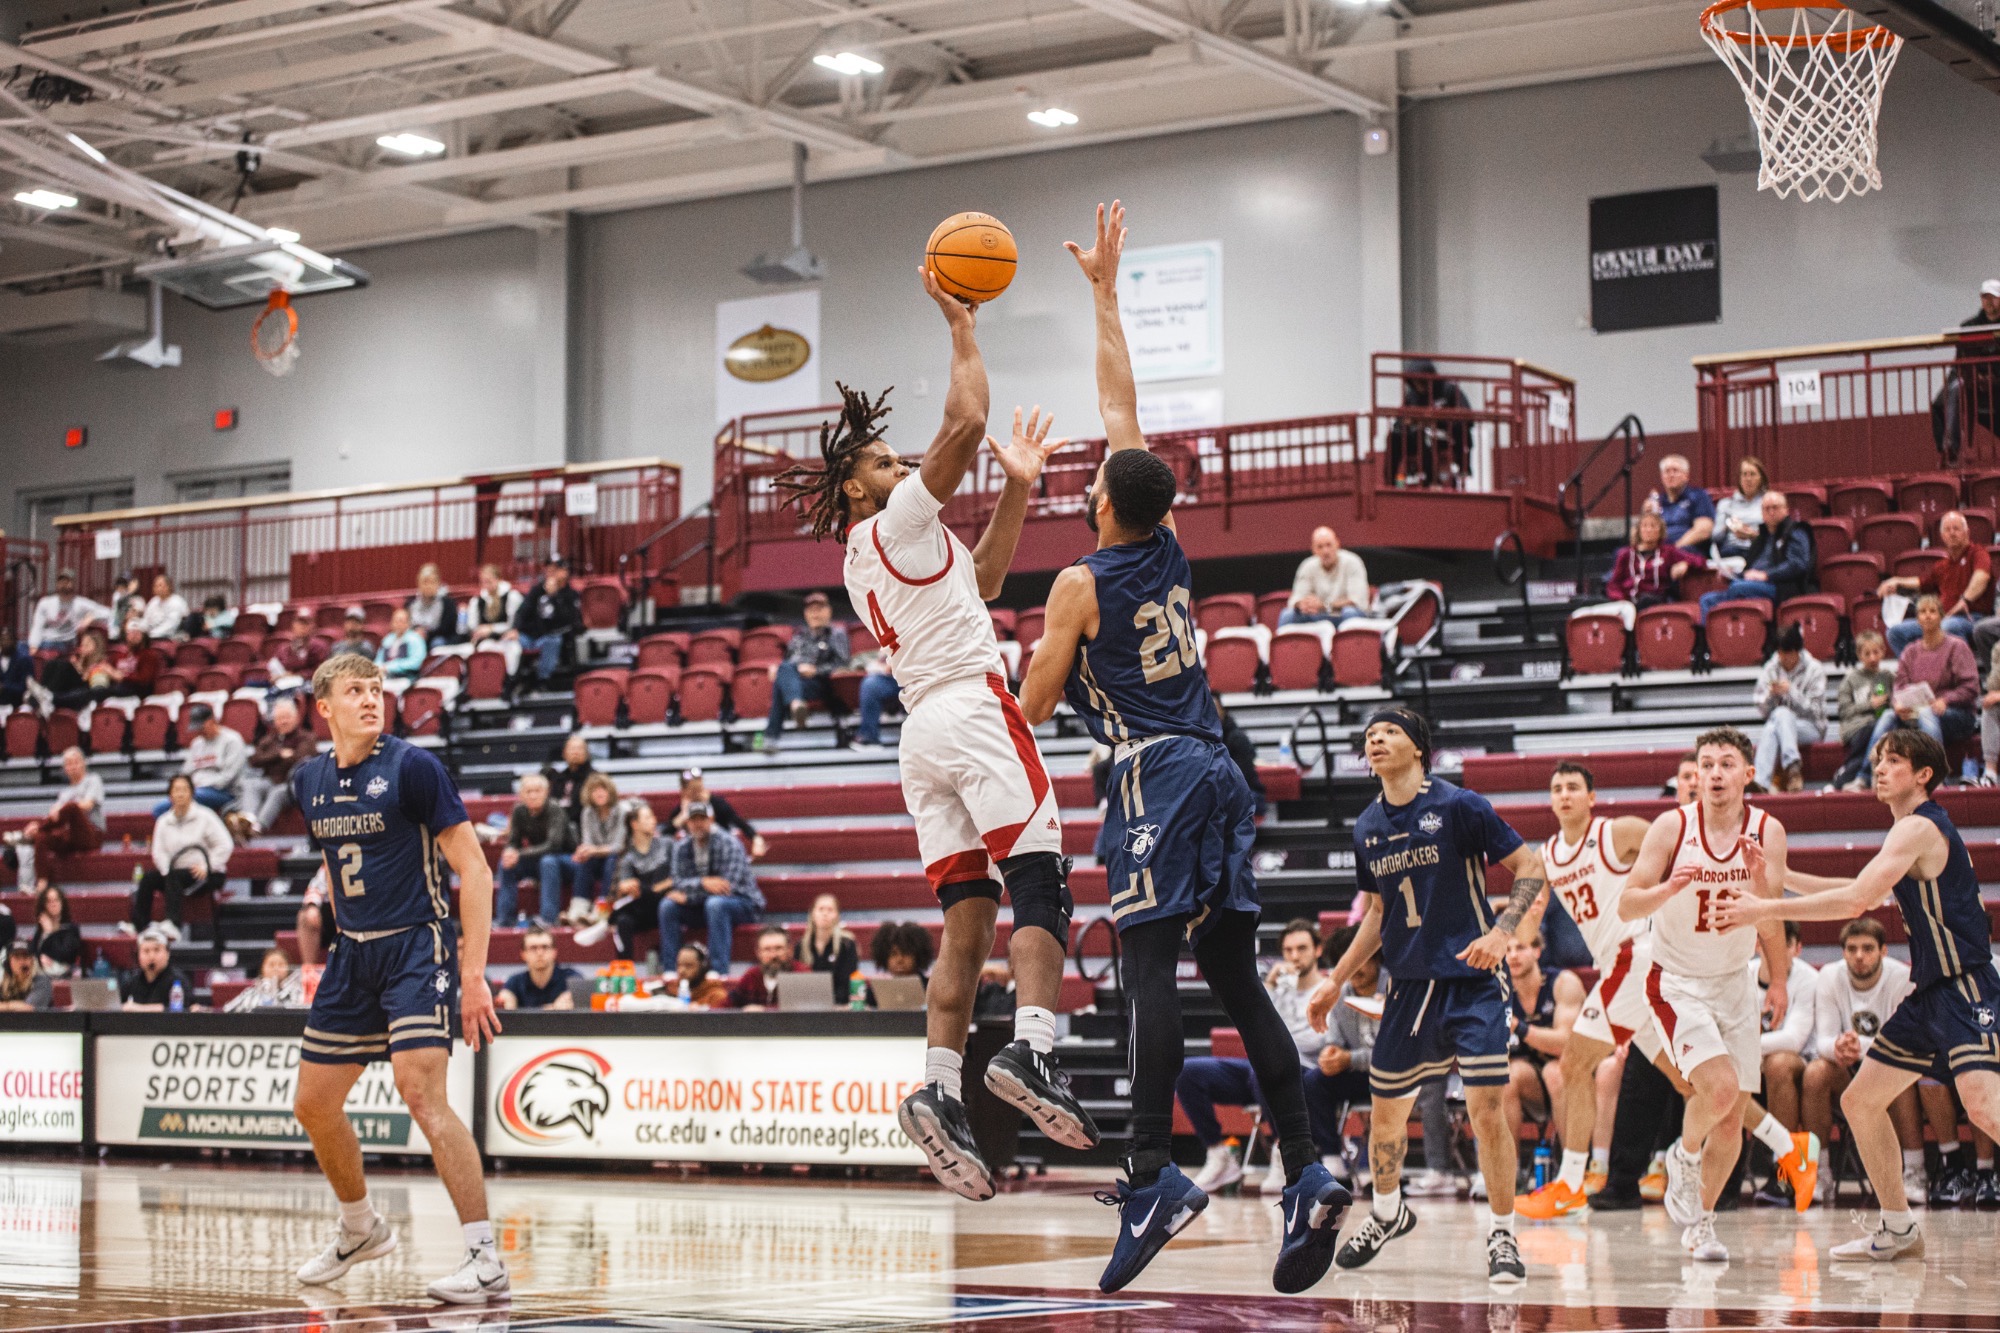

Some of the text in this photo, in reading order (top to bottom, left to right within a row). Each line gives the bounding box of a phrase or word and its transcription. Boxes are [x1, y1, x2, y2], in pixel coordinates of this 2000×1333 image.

[1664, 243, 1704, 263] DAY
[1788, 379, 1816, 396] 104
[866, 589, 901, 657] 4
[1133, 584, 1197, 685] 20
[338, 843, 365, 897] 2
[1398, 876, 1422, 928] 1
[1563, 883, 1599, 925] 23
[152, 1042, 301, 1070] ORTHOPED
[3, 1070, 82, 1099] COLLEGE
[145, 1075, 257, 1103] SPORTS
[624, 1079, 742, 1111] CHADRON
[752, 1081, 822, 1113] STATE
[832, 1081, 925, 1114] COLLE
[0, 1104, 75, 1133] agles.com
[635, 1118, 917, 1155] csc.edu chadroneagles.co
